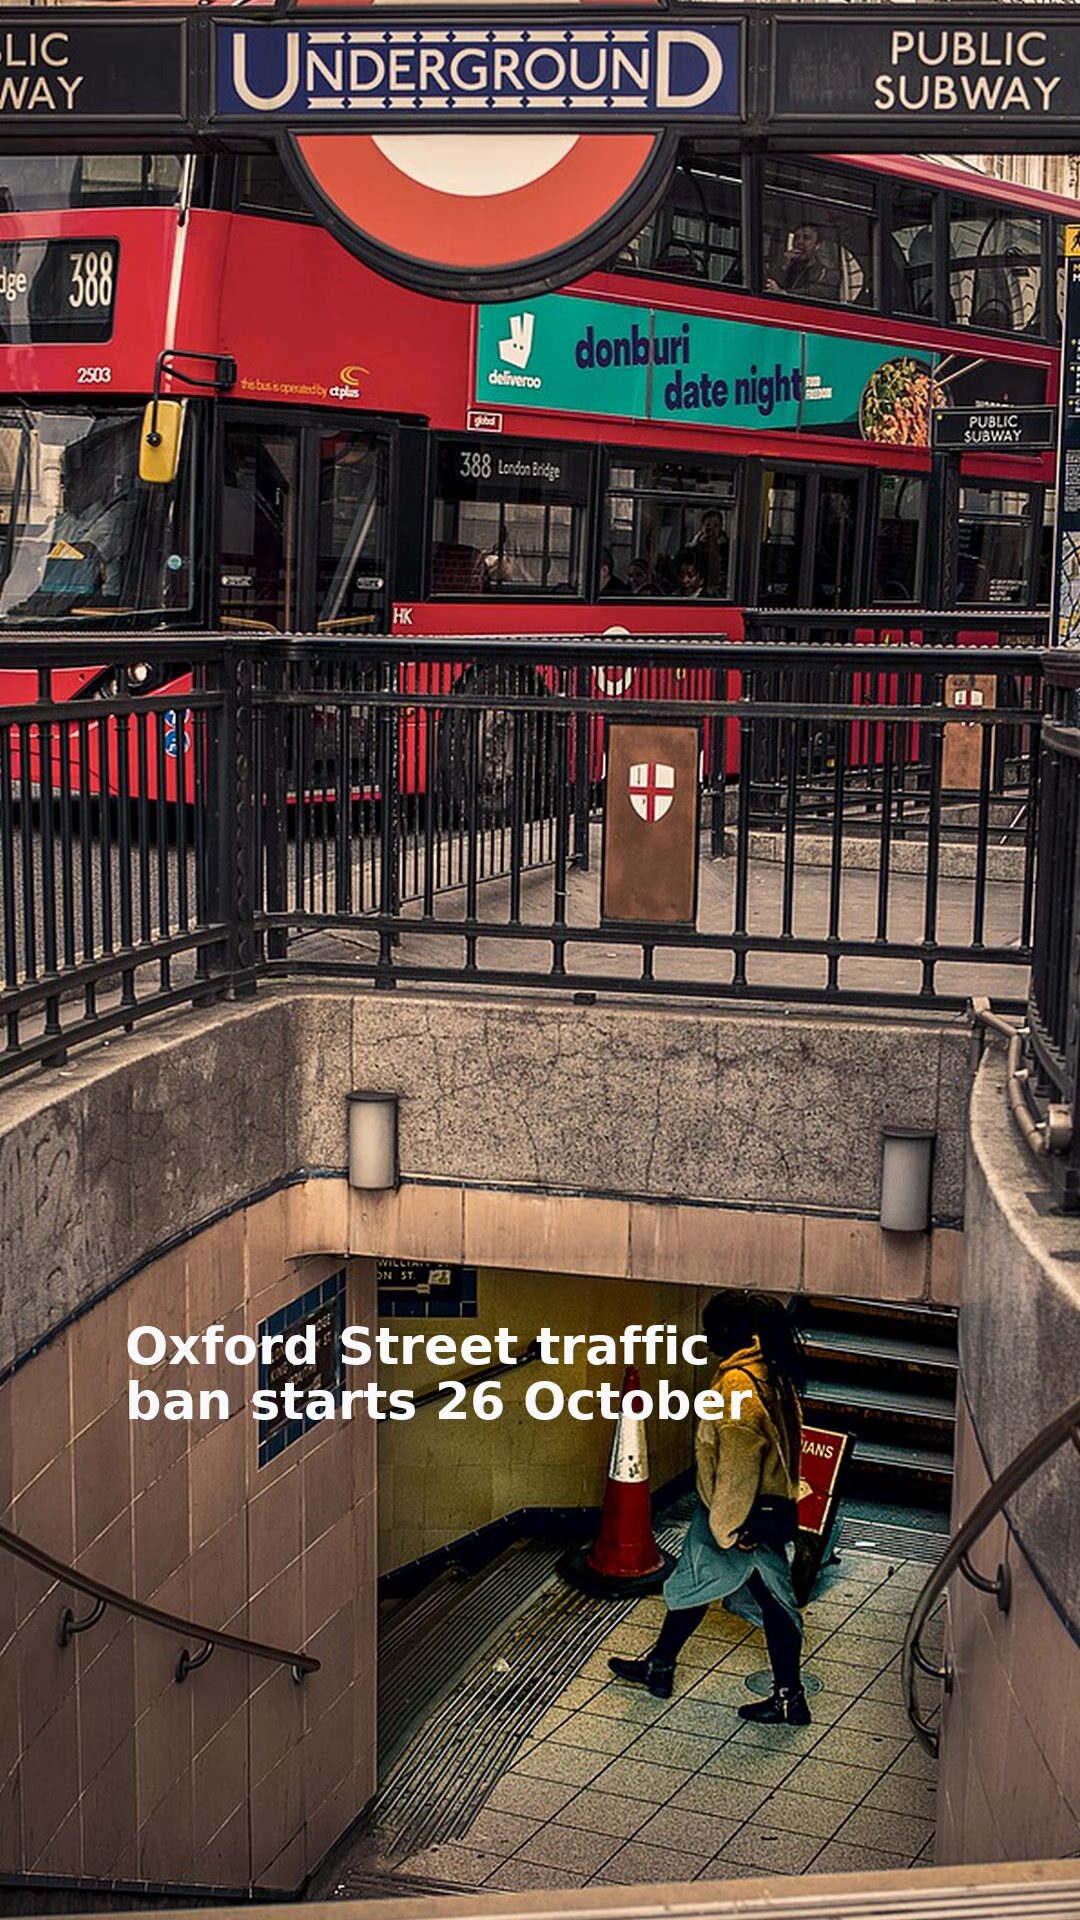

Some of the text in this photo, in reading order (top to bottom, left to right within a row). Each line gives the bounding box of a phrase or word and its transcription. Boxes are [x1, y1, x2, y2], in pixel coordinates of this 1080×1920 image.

[0, 32, 68, 67] LIC
[891, 31, 1047, 67] PUBLIC
[232, 30, 724, 112] UNDERGROUND
[874, 75, 1061, 111] SUBWAY
[69, 251, 113, 308] 388
[575, 322, 690, 369] donburi
[77, 367, 111, 383] 2503
[256, 379, 271, 391] bus
[488, 369, 541, 389] deliveroo
[664, 364, 803, 416] date night
[964, 430, 1022, 443] SUBWAY
[969, 415, 1018, 429] PUBLIC
[460, 452, 560, 481] 388 London Bridge
[392, 607, 413, 625] HK
[801, 1440, 834, 1459] IANS
